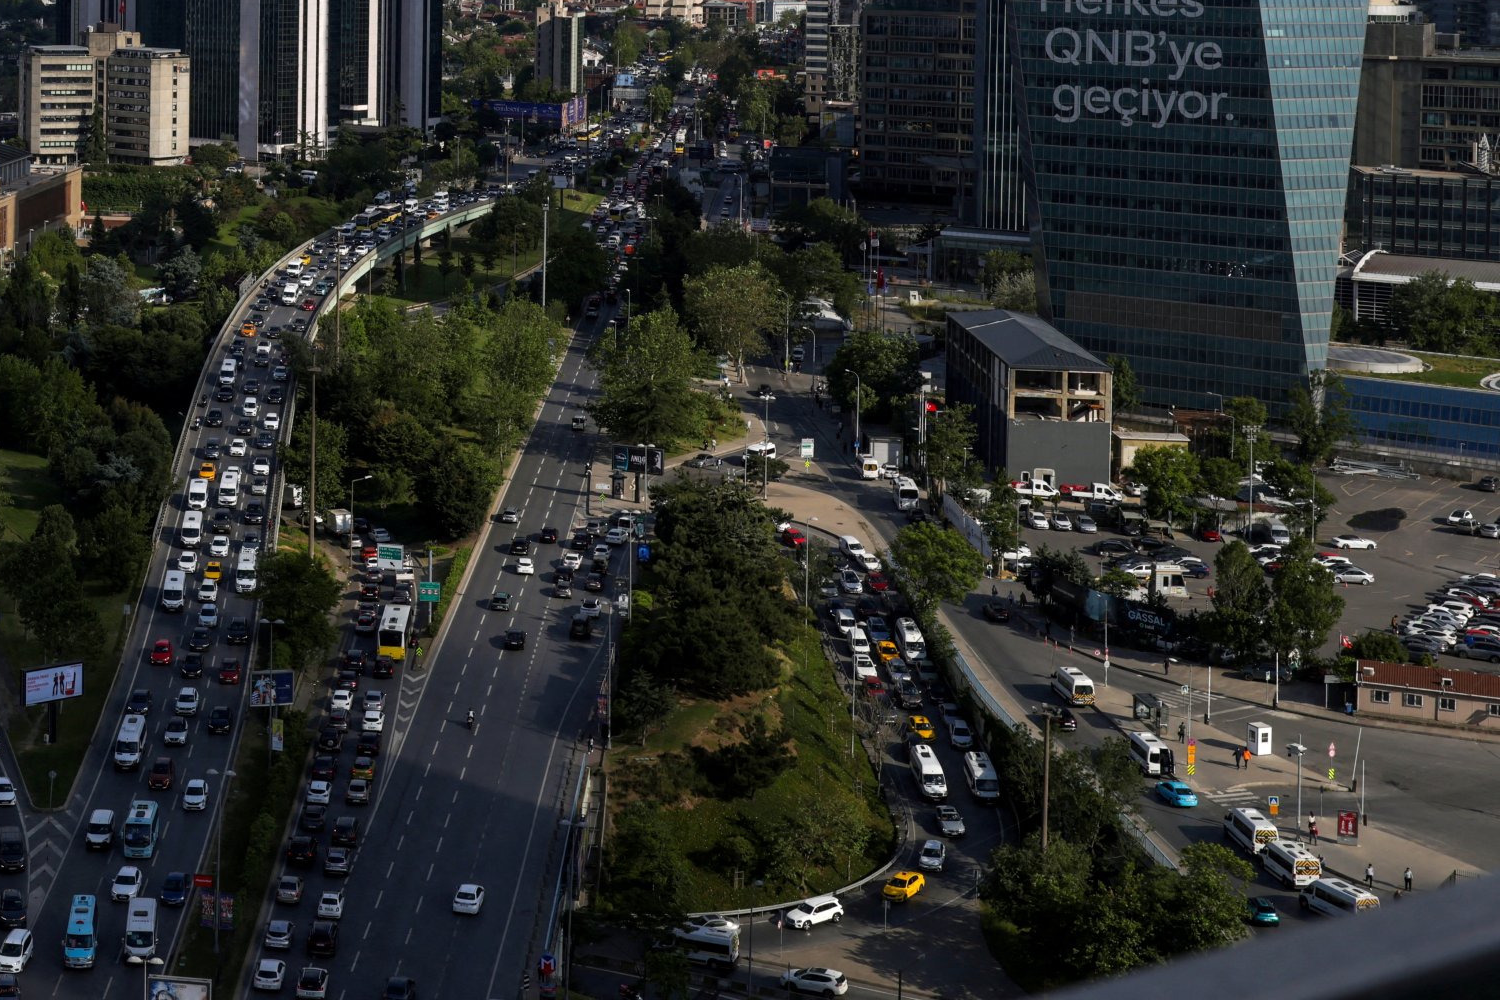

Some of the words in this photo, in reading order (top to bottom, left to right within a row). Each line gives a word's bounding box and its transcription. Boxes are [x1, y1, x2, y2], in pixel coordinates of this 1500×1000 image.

[1045, 27, 1223, 81] QNB'ye
[1052, 77, 1235, 129] geçiyor.
[1128, 610, 1166, 626] GASSAL
